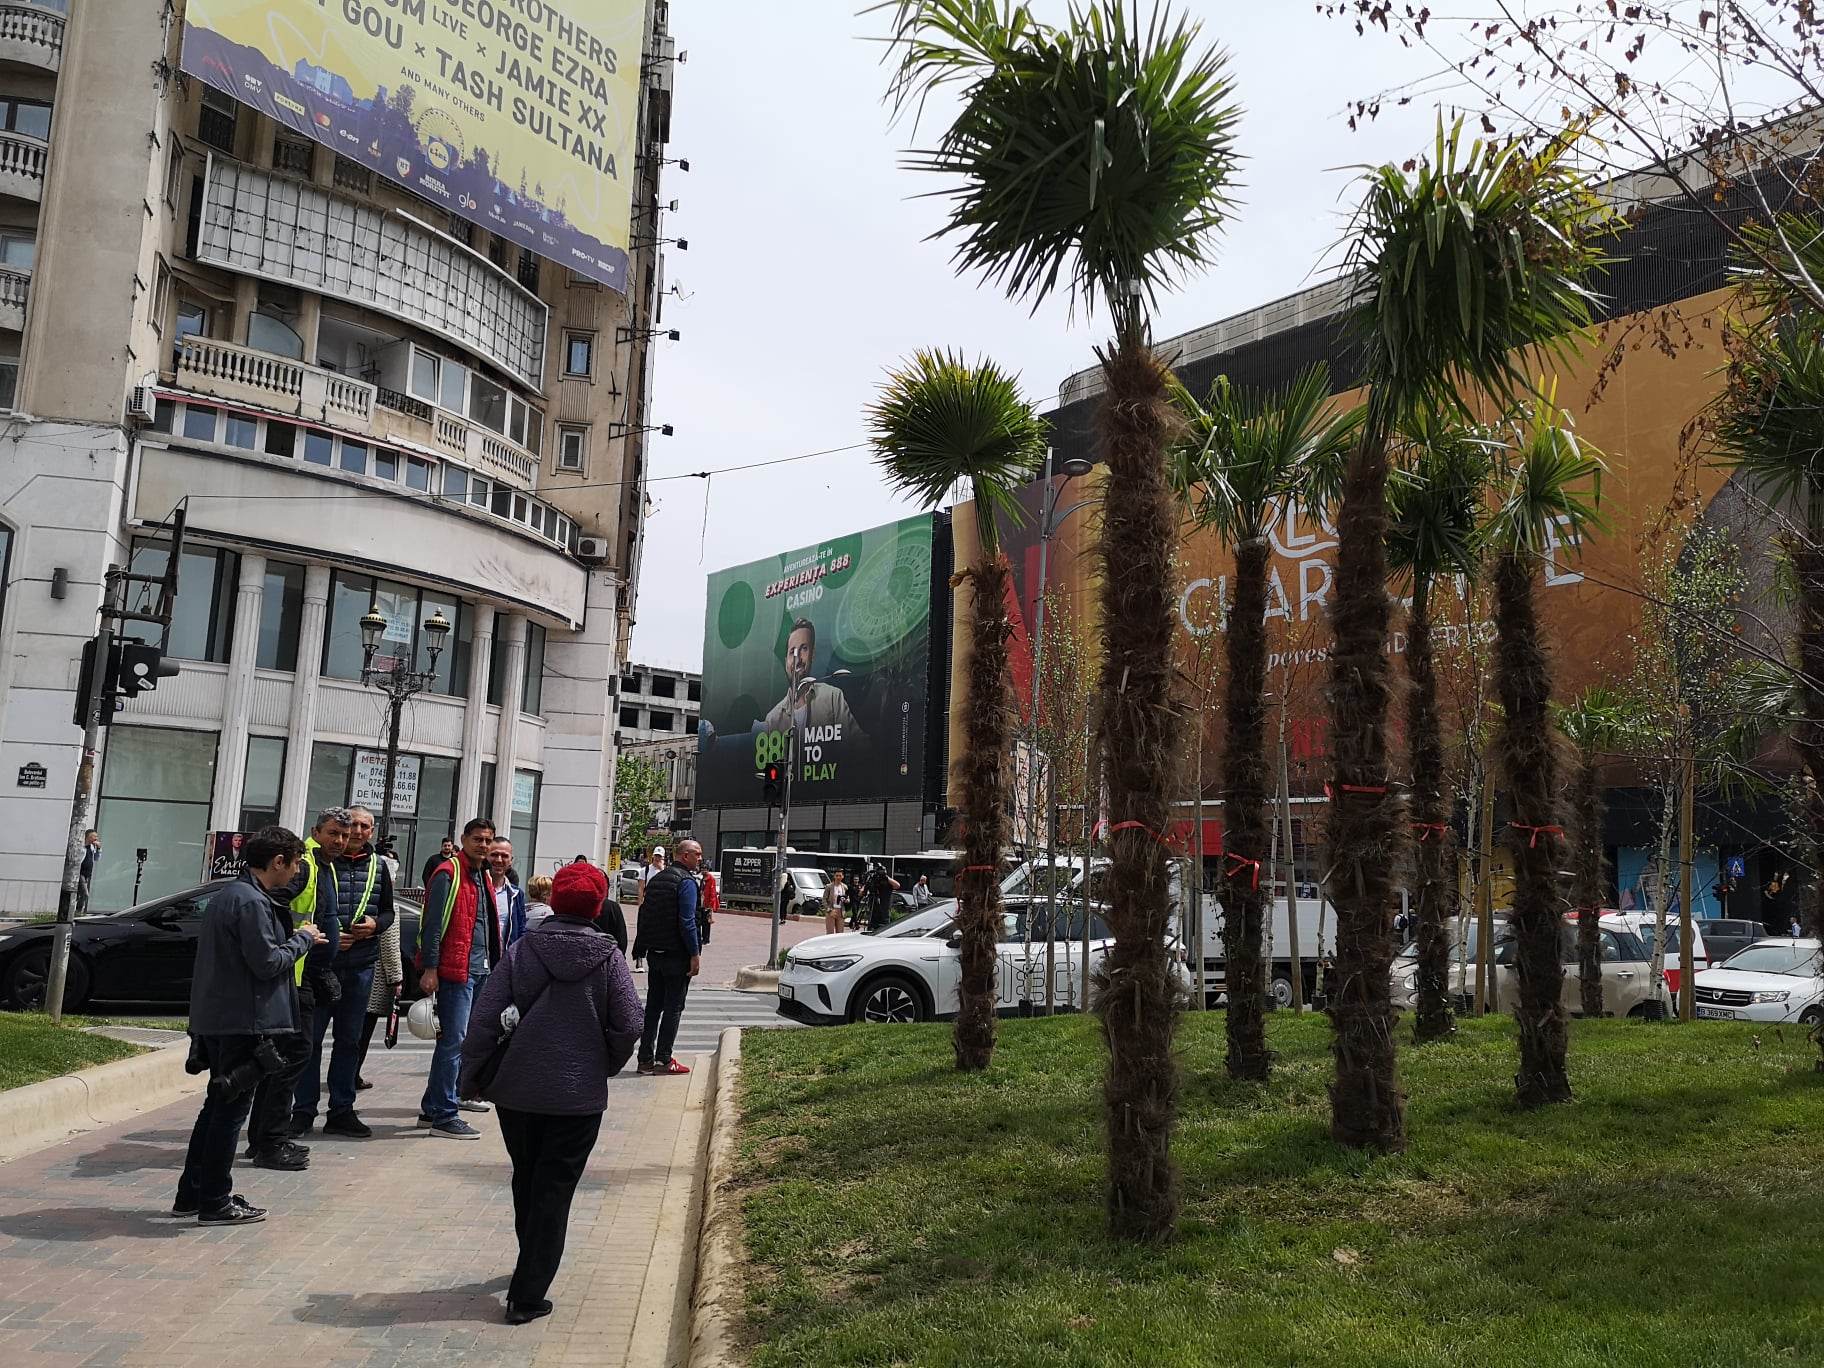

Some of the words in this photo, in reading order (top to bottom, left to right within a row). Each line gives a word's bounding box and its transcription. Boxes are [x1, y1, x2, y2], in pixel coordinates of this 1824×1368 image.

[446, 0, 544, 63] EORGE
[552, 46, 609, 105] EZRA
[432, 5, 468, 40] LIVE
[496, 50, 571, 117] JAMIE
[577, 100, 607, 138] XX
[342, 0, 403, 50] GOU
[435, 46, 503, 112] TASH
[512, 97, 617, 180] SULTANA
[400, 66, 421, 83] AND
[424, 78, 450, 99] MANY
[452, 96, 485, 122] OTHERS
[458, 192, 477, 210] glo
[830, 553, 850, 574] 888
[786, 585, 823, 610] CASINO
[804, 723, 842, 743] MADE
[804, 745, 822, 763] TO
[804, 763, 837, 781] PLAY
[357, 790, 369, 798] DE
[743, 857, 761, 867] ZIPPER
